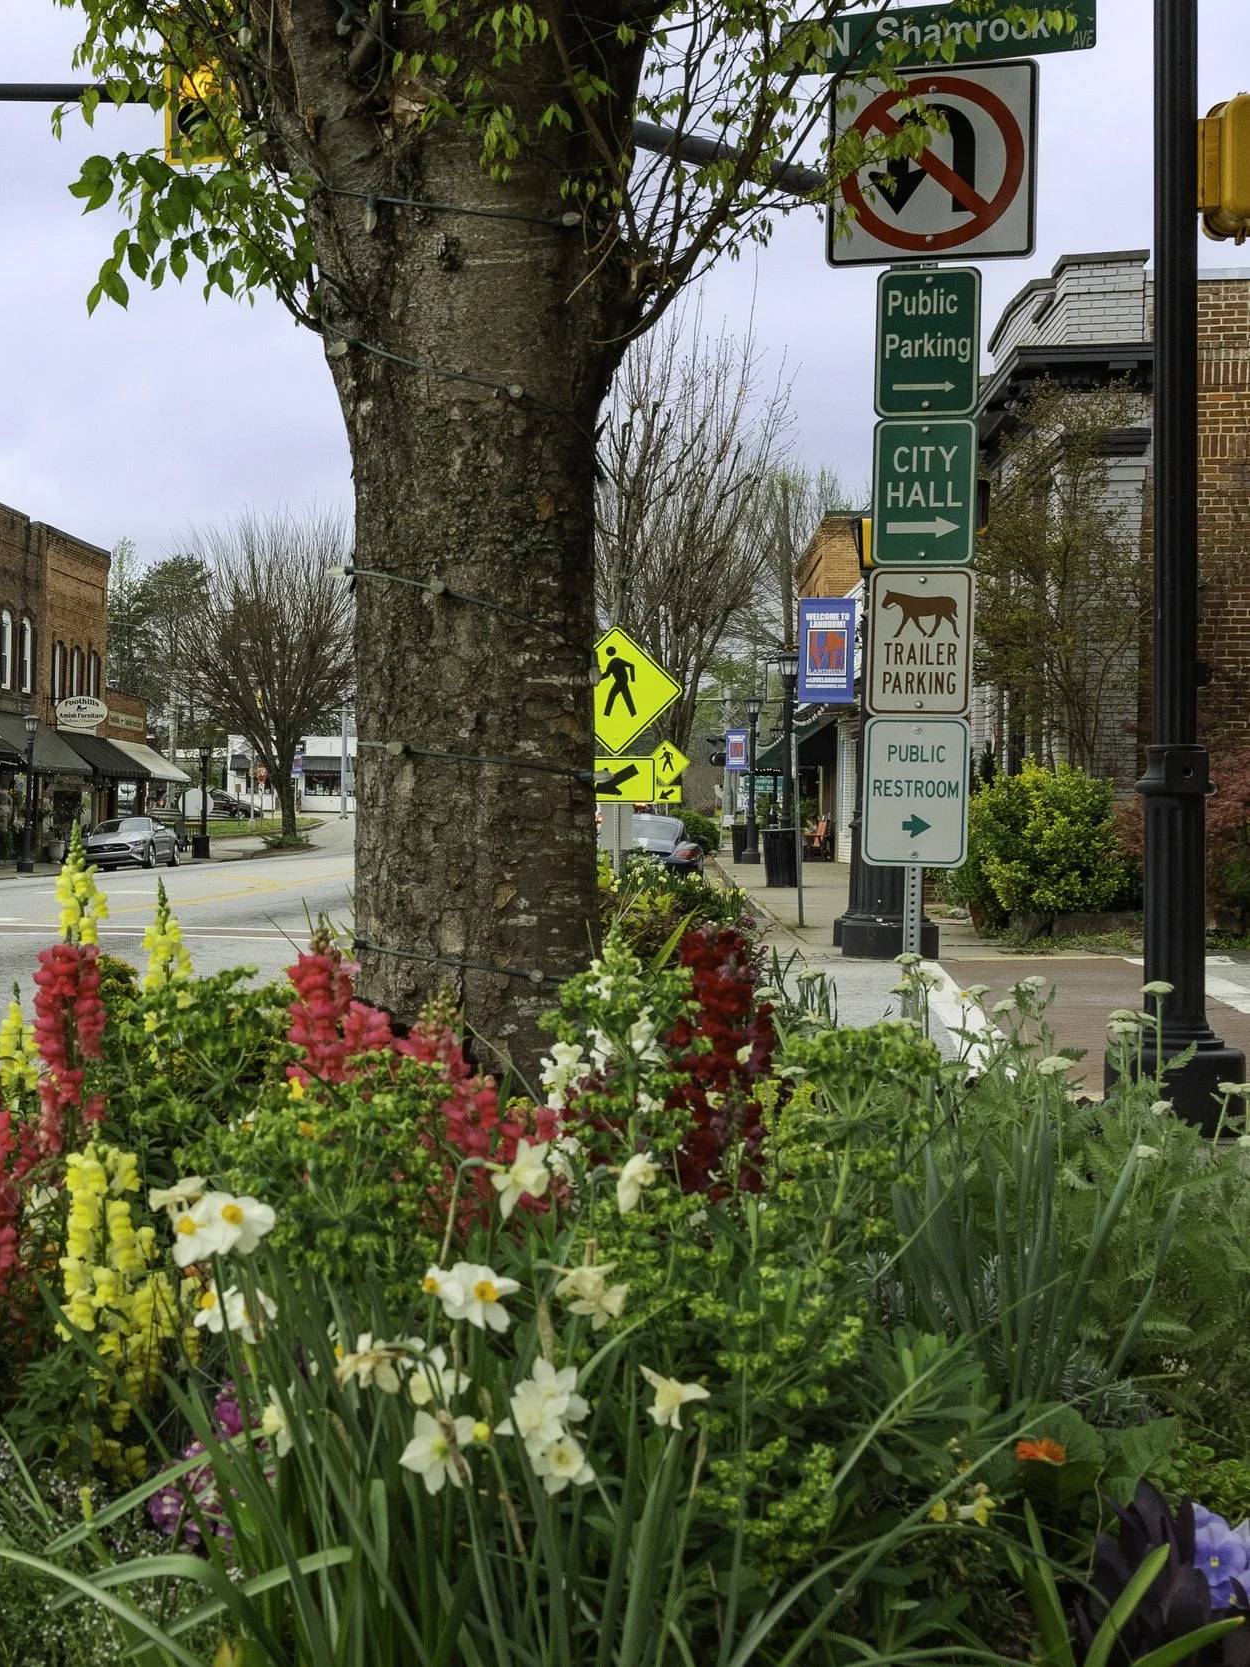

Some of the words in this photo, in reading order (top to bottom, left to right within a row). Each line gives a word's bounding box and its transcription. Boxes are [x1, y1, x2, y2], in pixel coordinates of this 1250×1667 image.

[826, 22, 850, 58] N
[1071, 29, 1095, 49] AVE
[887, 288, 958, 317] Public
[885, 332, 971, 363] Parking
[893, 446, 958, 473] CITY
[886, 480, 963, 508] HALL
[805, 612, 839, 621] WELCOME
[841, 613, 850, 621] TO
[810, 620, 846, 629] LANDRUM!
[884, 642, 957, 666] TRAILER
[882, 671, 957, 695] PARKING
[64, 697, 100, 707] Foothills
[887, 745, 946, 763] PUBLIC
[873, 780, 959, 798] RESTROOM
